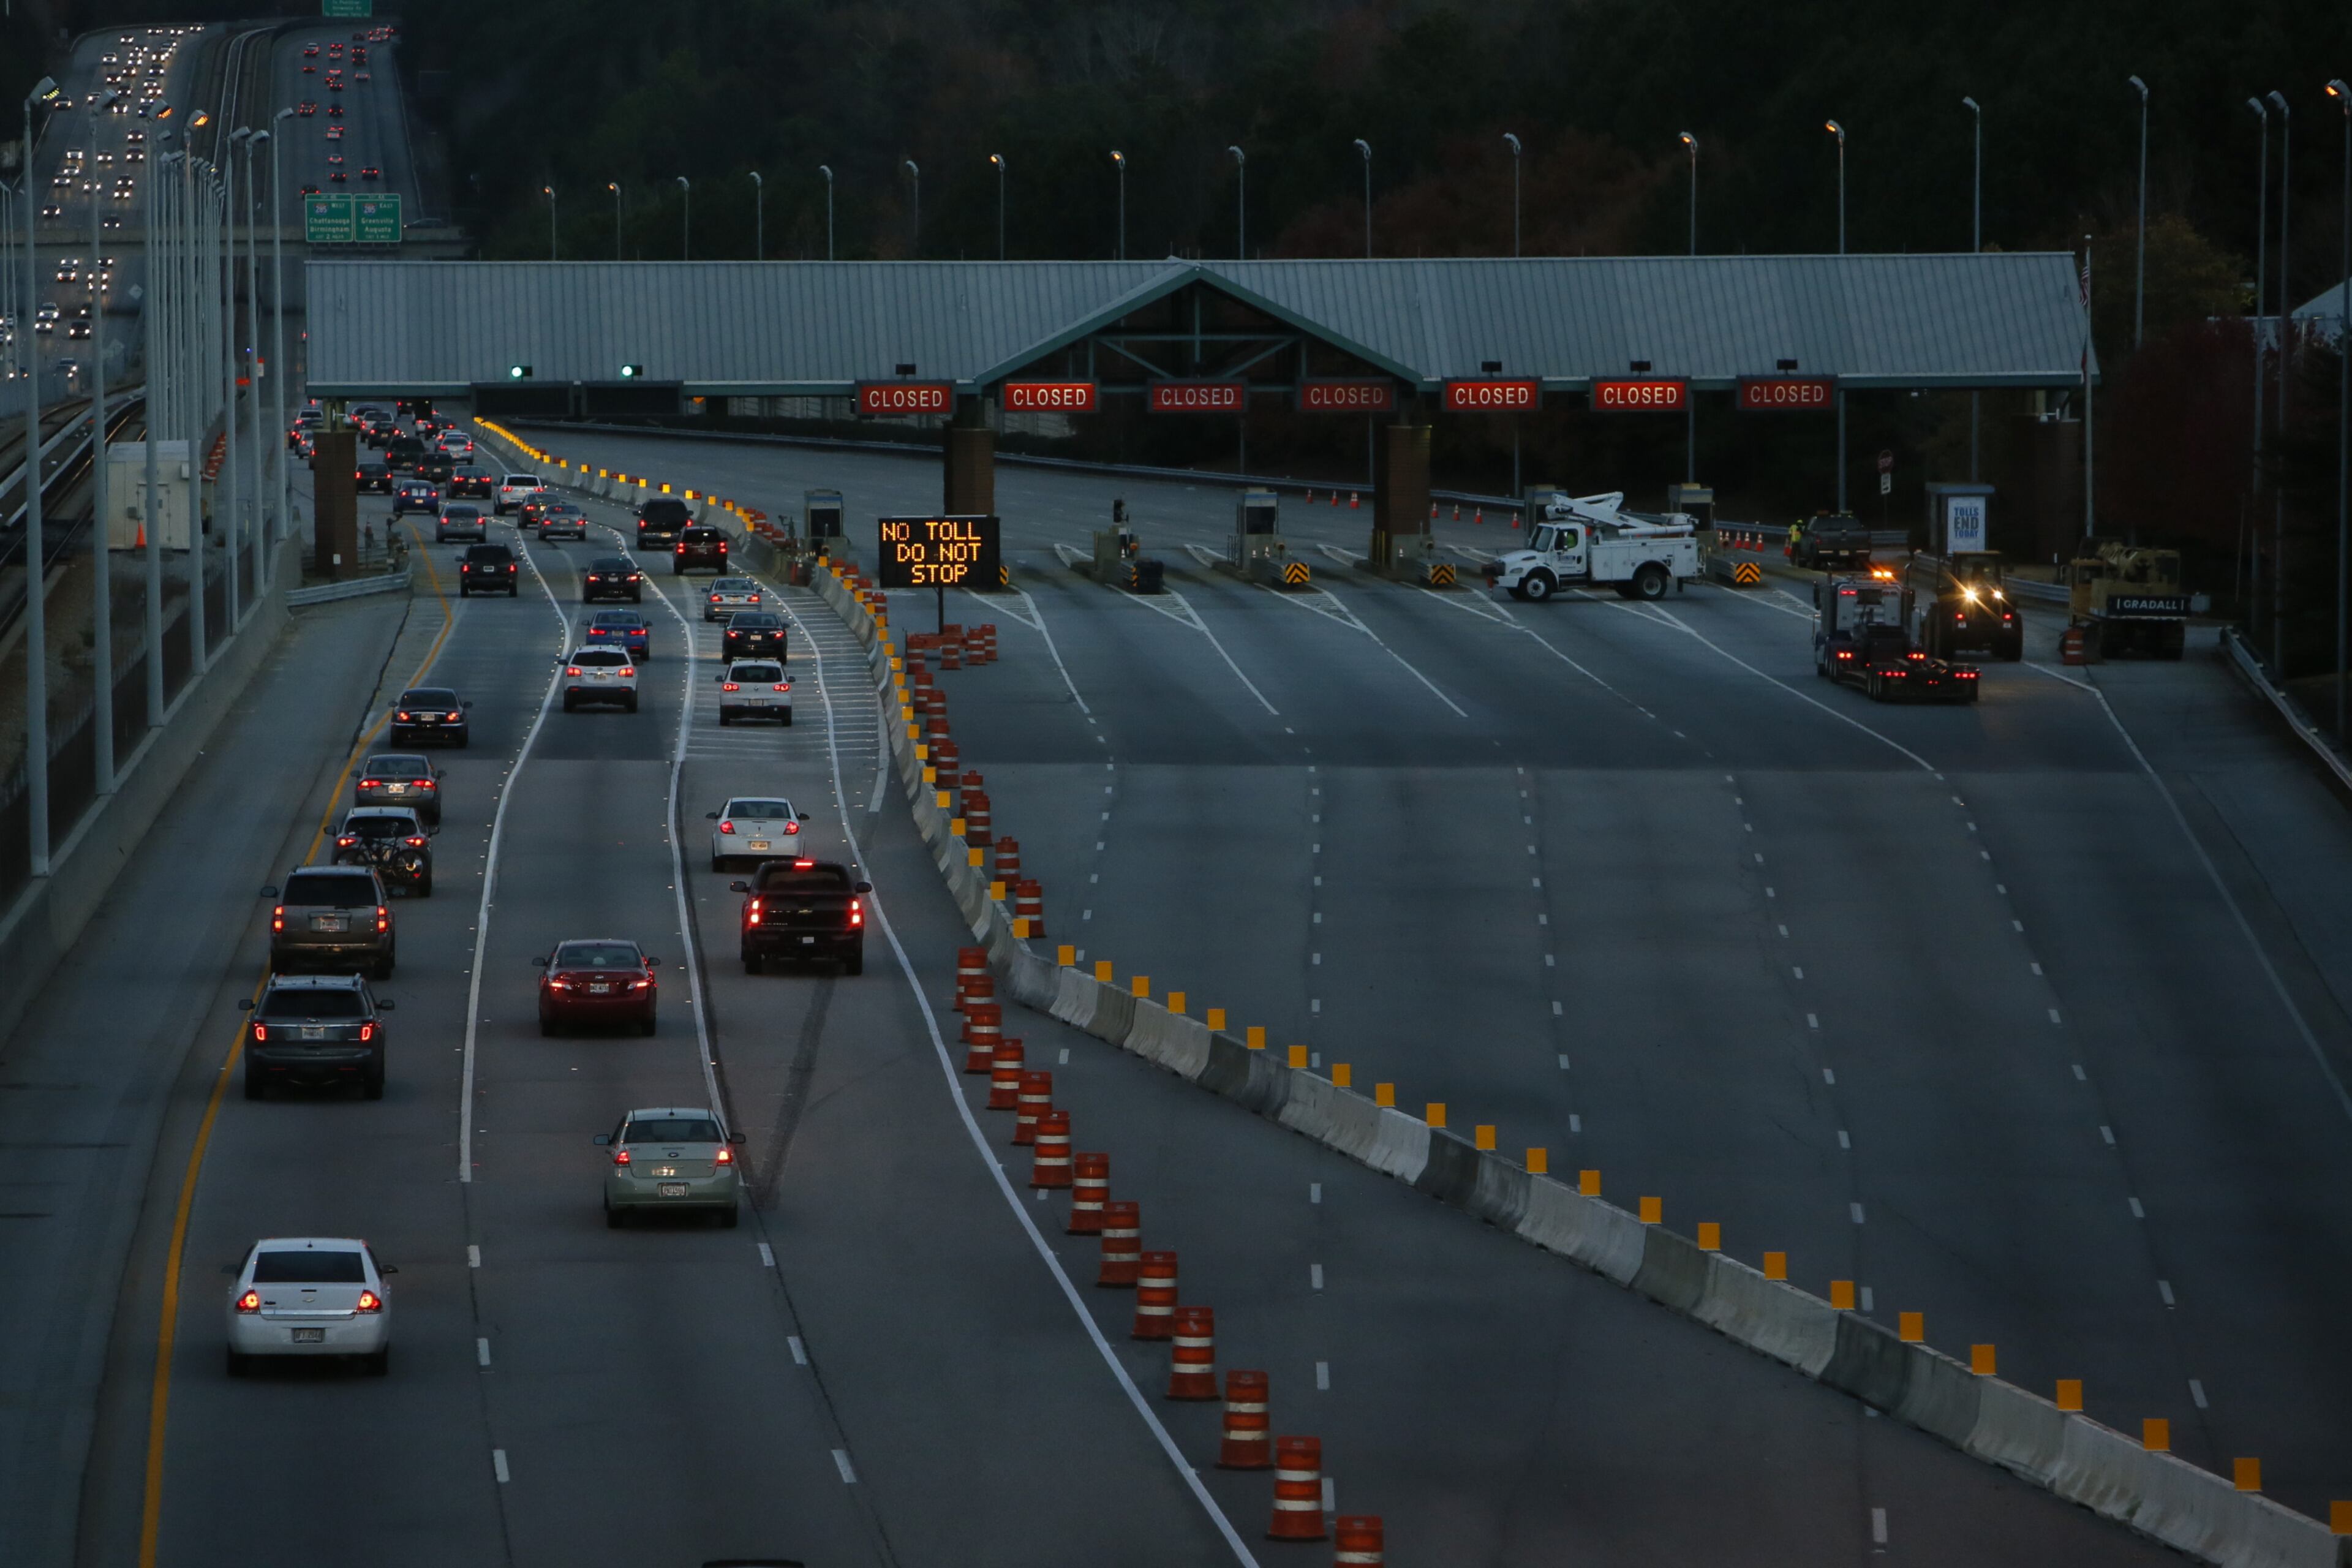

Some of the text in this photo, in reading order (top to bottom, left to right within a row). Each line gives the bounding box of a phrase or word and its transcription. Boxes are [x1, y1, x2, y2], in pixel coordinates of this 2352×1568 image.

[870, 390, 942, 408] CLOSED
[1013, 388, 1087, 405] CLOSED
[1161, 388, 1235, 405] CLOSED
[1310, 386, 1383, 404] CLOSED
[1455, 387, 1528, 404] CLOSED
[1604, 386, 1677, 404] CLOSED
[1750, 385, 1823, 402] CLOSED
[1954, 507, 1979, 516] TOLLS
[882, 521, 982, 541] NO TOLL
[1954, 516, 1978, 529] END
[896, 543, 982, 562] DO NOT
[911, 564, 968, 583] STOP
[2123, 600, 2177, 609] GRADALL
